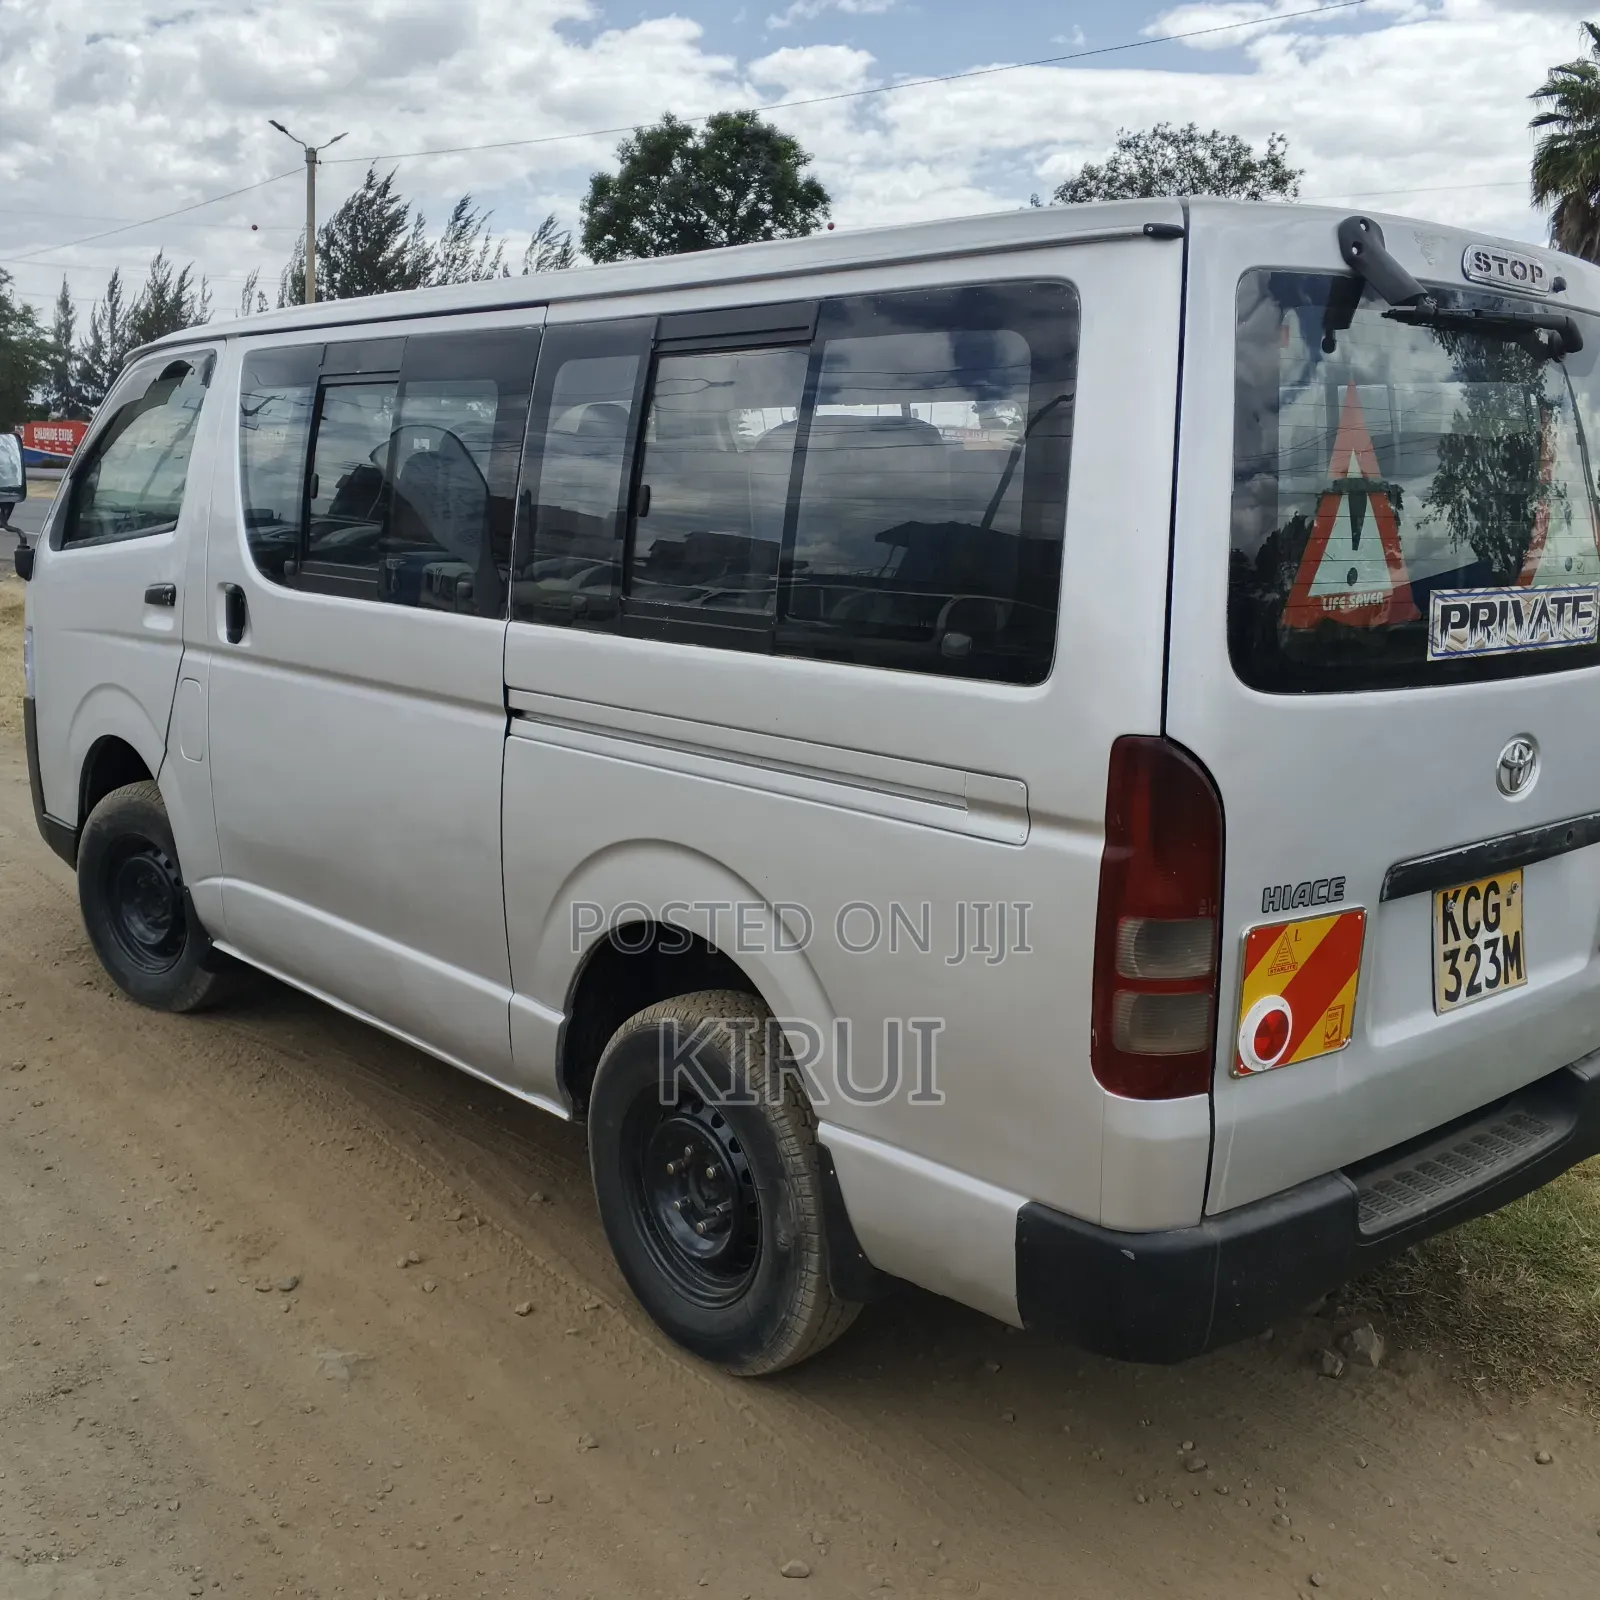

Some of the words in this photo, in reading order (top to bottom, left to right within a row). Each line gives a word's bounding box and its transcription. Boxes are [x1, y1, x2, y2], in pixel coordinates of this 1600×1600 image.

[1474, 251, 1543, 283] STOP
[34, 427, 57, 440] CHLORIDE
[58, 428, 73, 442] EXIDE
[1322, 596, 1345, 611] LIFE
[1349, 592, 1384, 609] SAVER
[1438, 594, 1594, 650] PRIVATE
[1262, 876, 1346, 913] HIACE
[1442, 880, 1500, 945] KCG
[1443, 931, 1523, 1002] 323M
